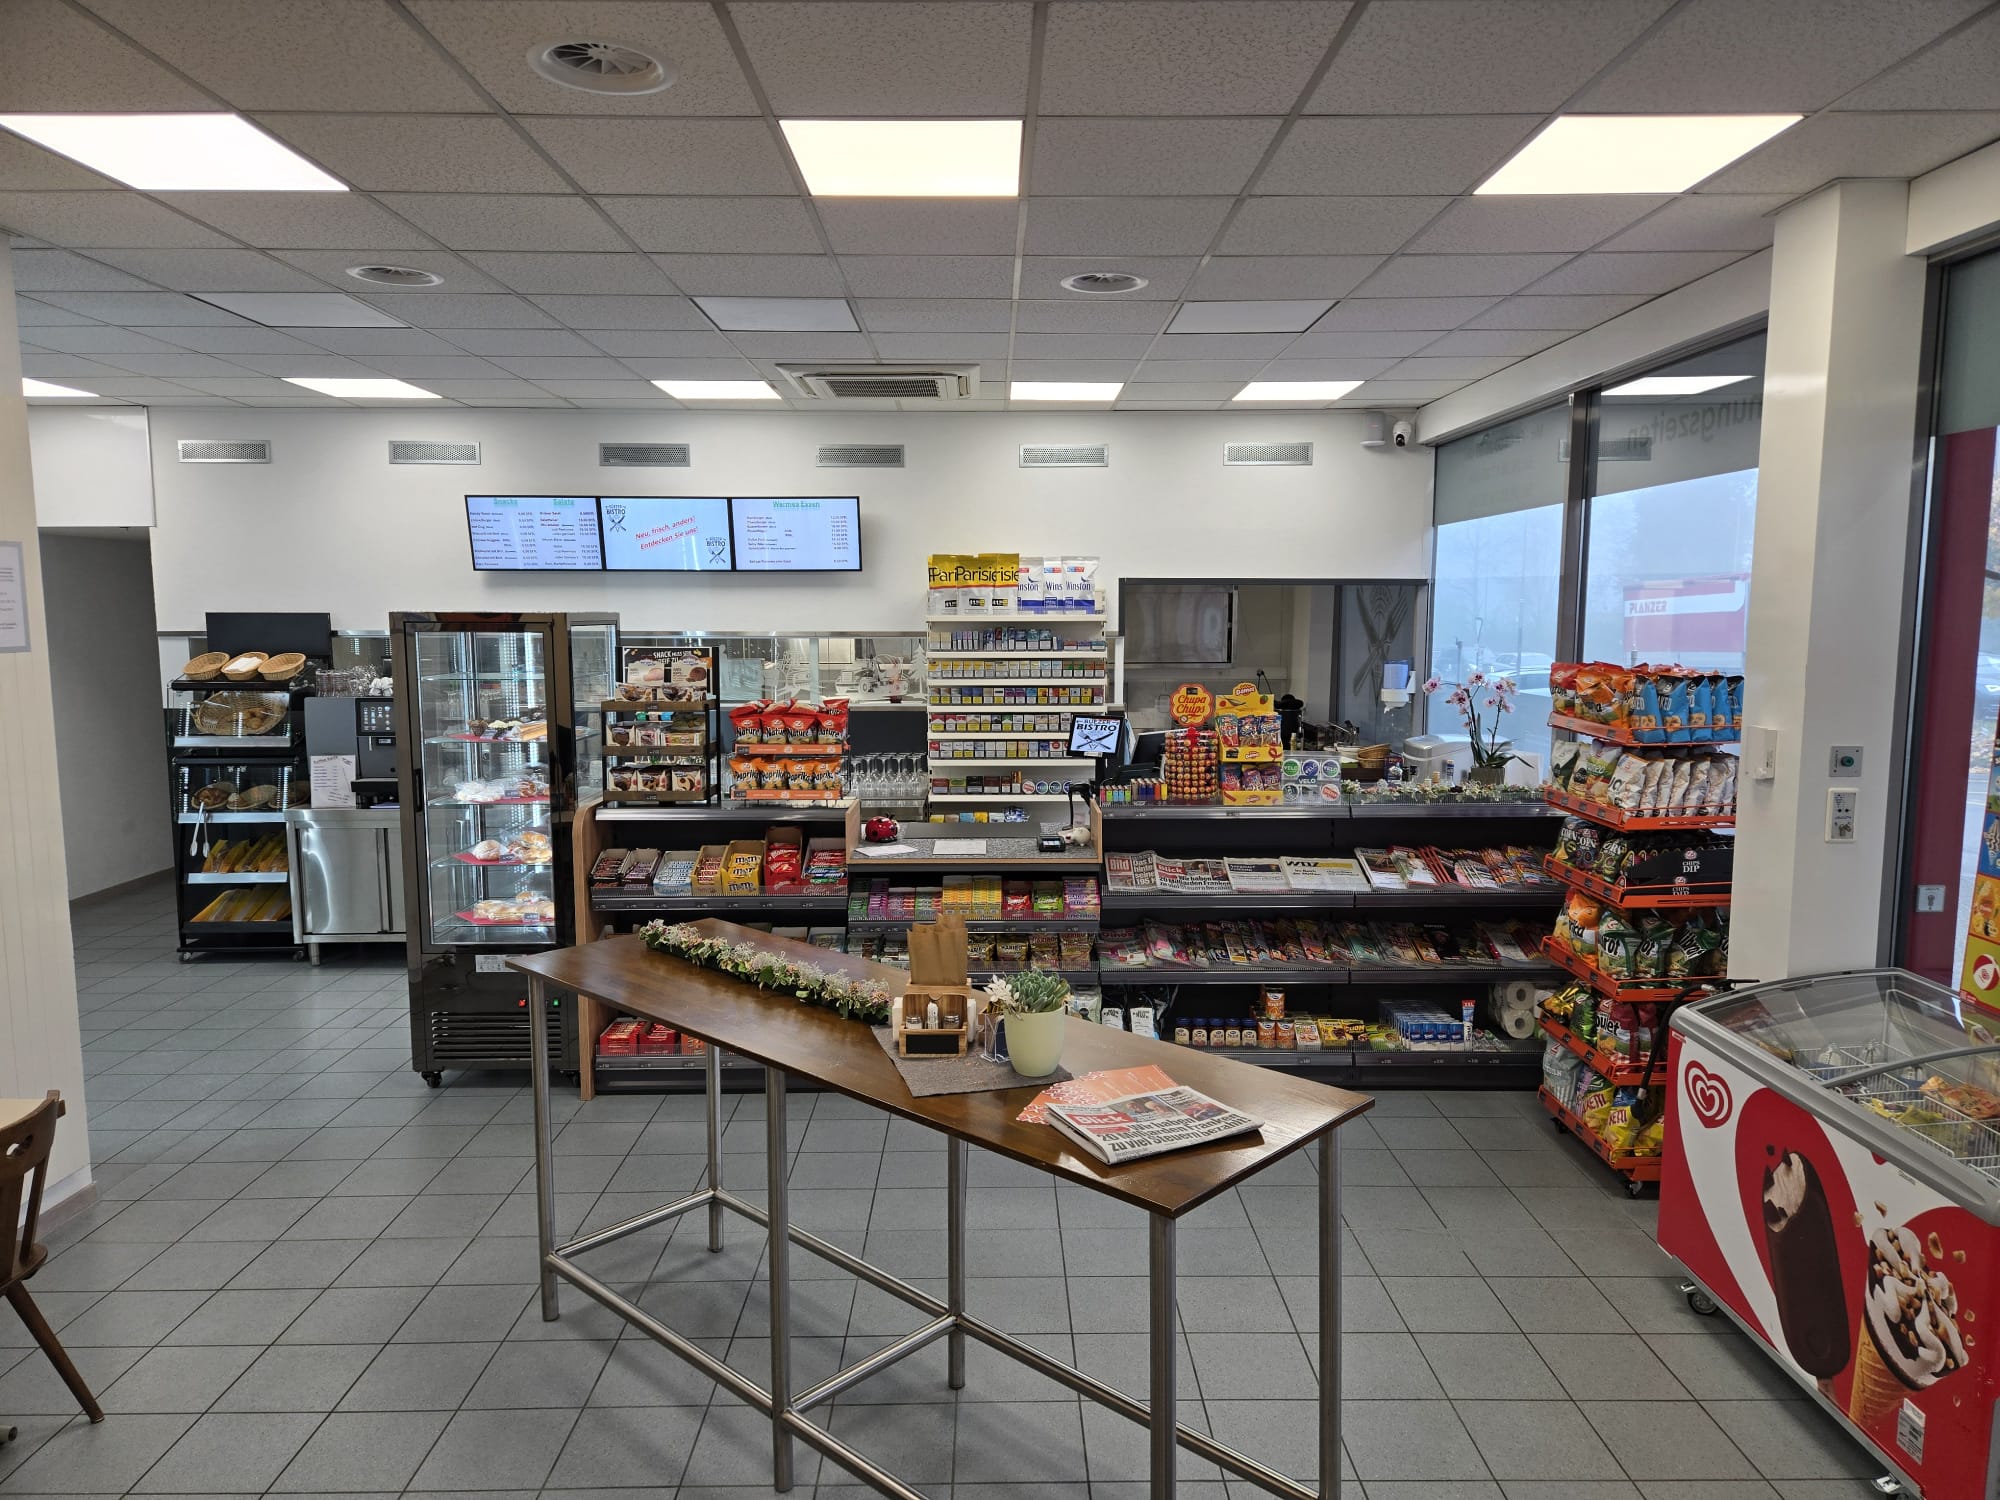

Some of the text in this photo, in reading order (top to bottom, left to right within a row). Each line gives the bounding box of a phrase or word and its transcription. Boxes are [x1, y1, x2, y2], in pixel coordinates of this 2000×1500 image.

[672, 516, 695, 528] anders!
[640, 536, 673, 550] Entdecken
[674, 531, 684, 539] Sie
[1629, 600, 1667, 614] PLANZER
[1177, 695, 1207, 704] Chupa
[1176, 704, 1205, 714] Chups
[1076, 723, 1117, 731] BISTRO
[1110, 859, 1130, 870] Bild
[1157, 864, 1182, 873] Blick
[1074, 1114, 1128, 1124] Blick
[1128, 1117, 1197, 1131] Wir haben
[1102, 1114, 1241, 1141] 20 Milliarden Franken
[1108, 1116, 1252, 1151] zu viel Steuern bezahlt!
